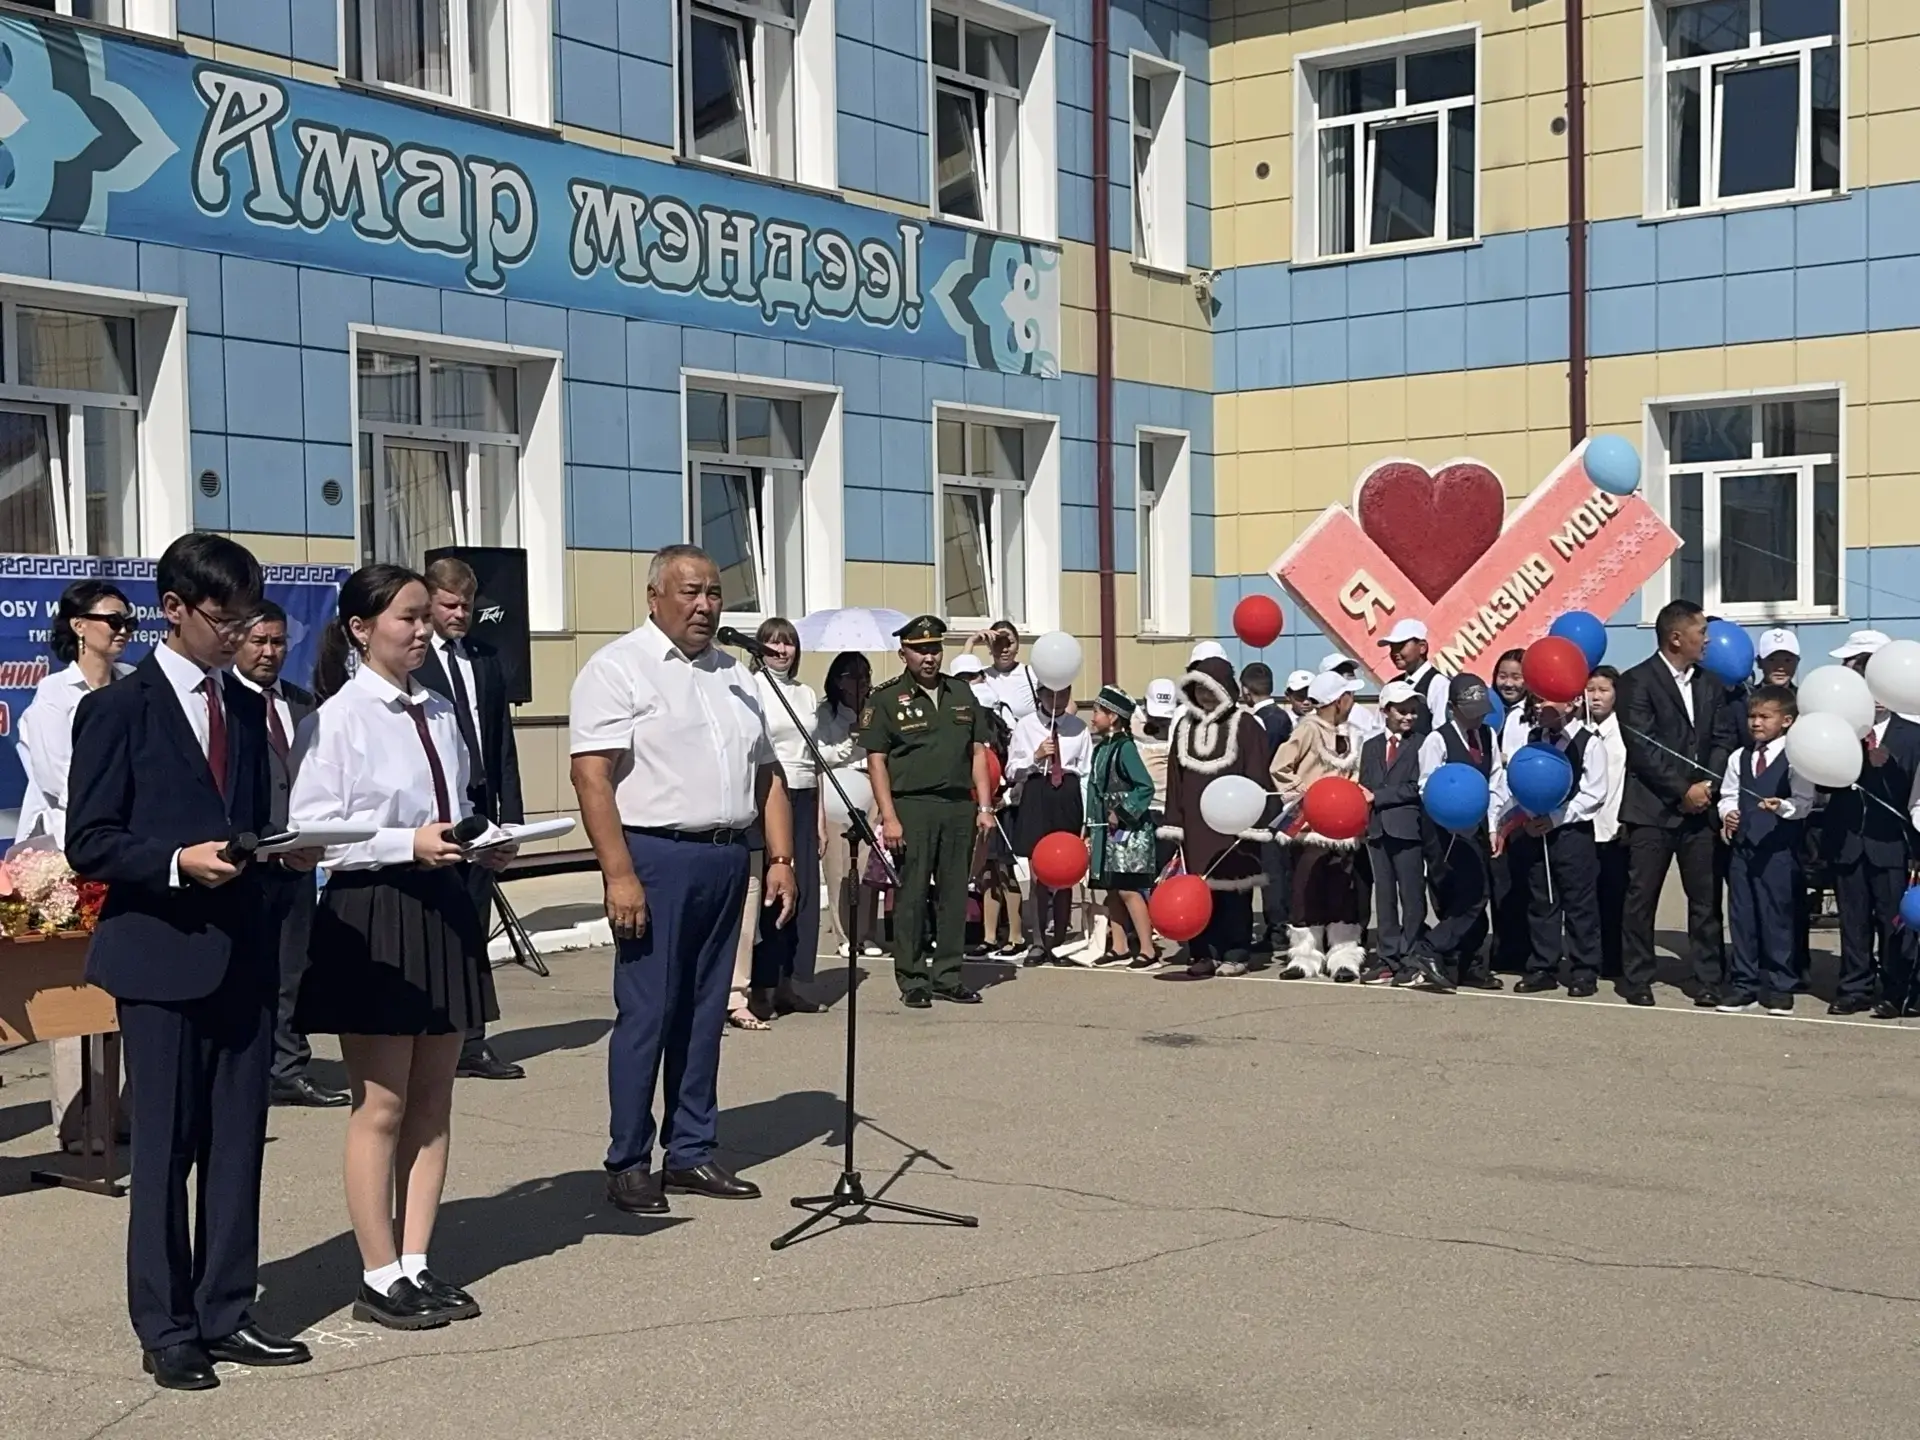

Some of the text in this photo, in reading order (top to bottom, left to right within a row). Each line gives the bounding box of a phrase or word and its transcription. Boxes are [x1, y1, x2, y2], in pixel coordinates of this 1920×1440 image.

[194, 64, 924, 331] Амар мэндээ!
[1338, 568, 1395, 631] Я
[1433, 488, 1619, 677] ИМНАЗИЮ МОЮ
[0, 654, 49, 689] ний
